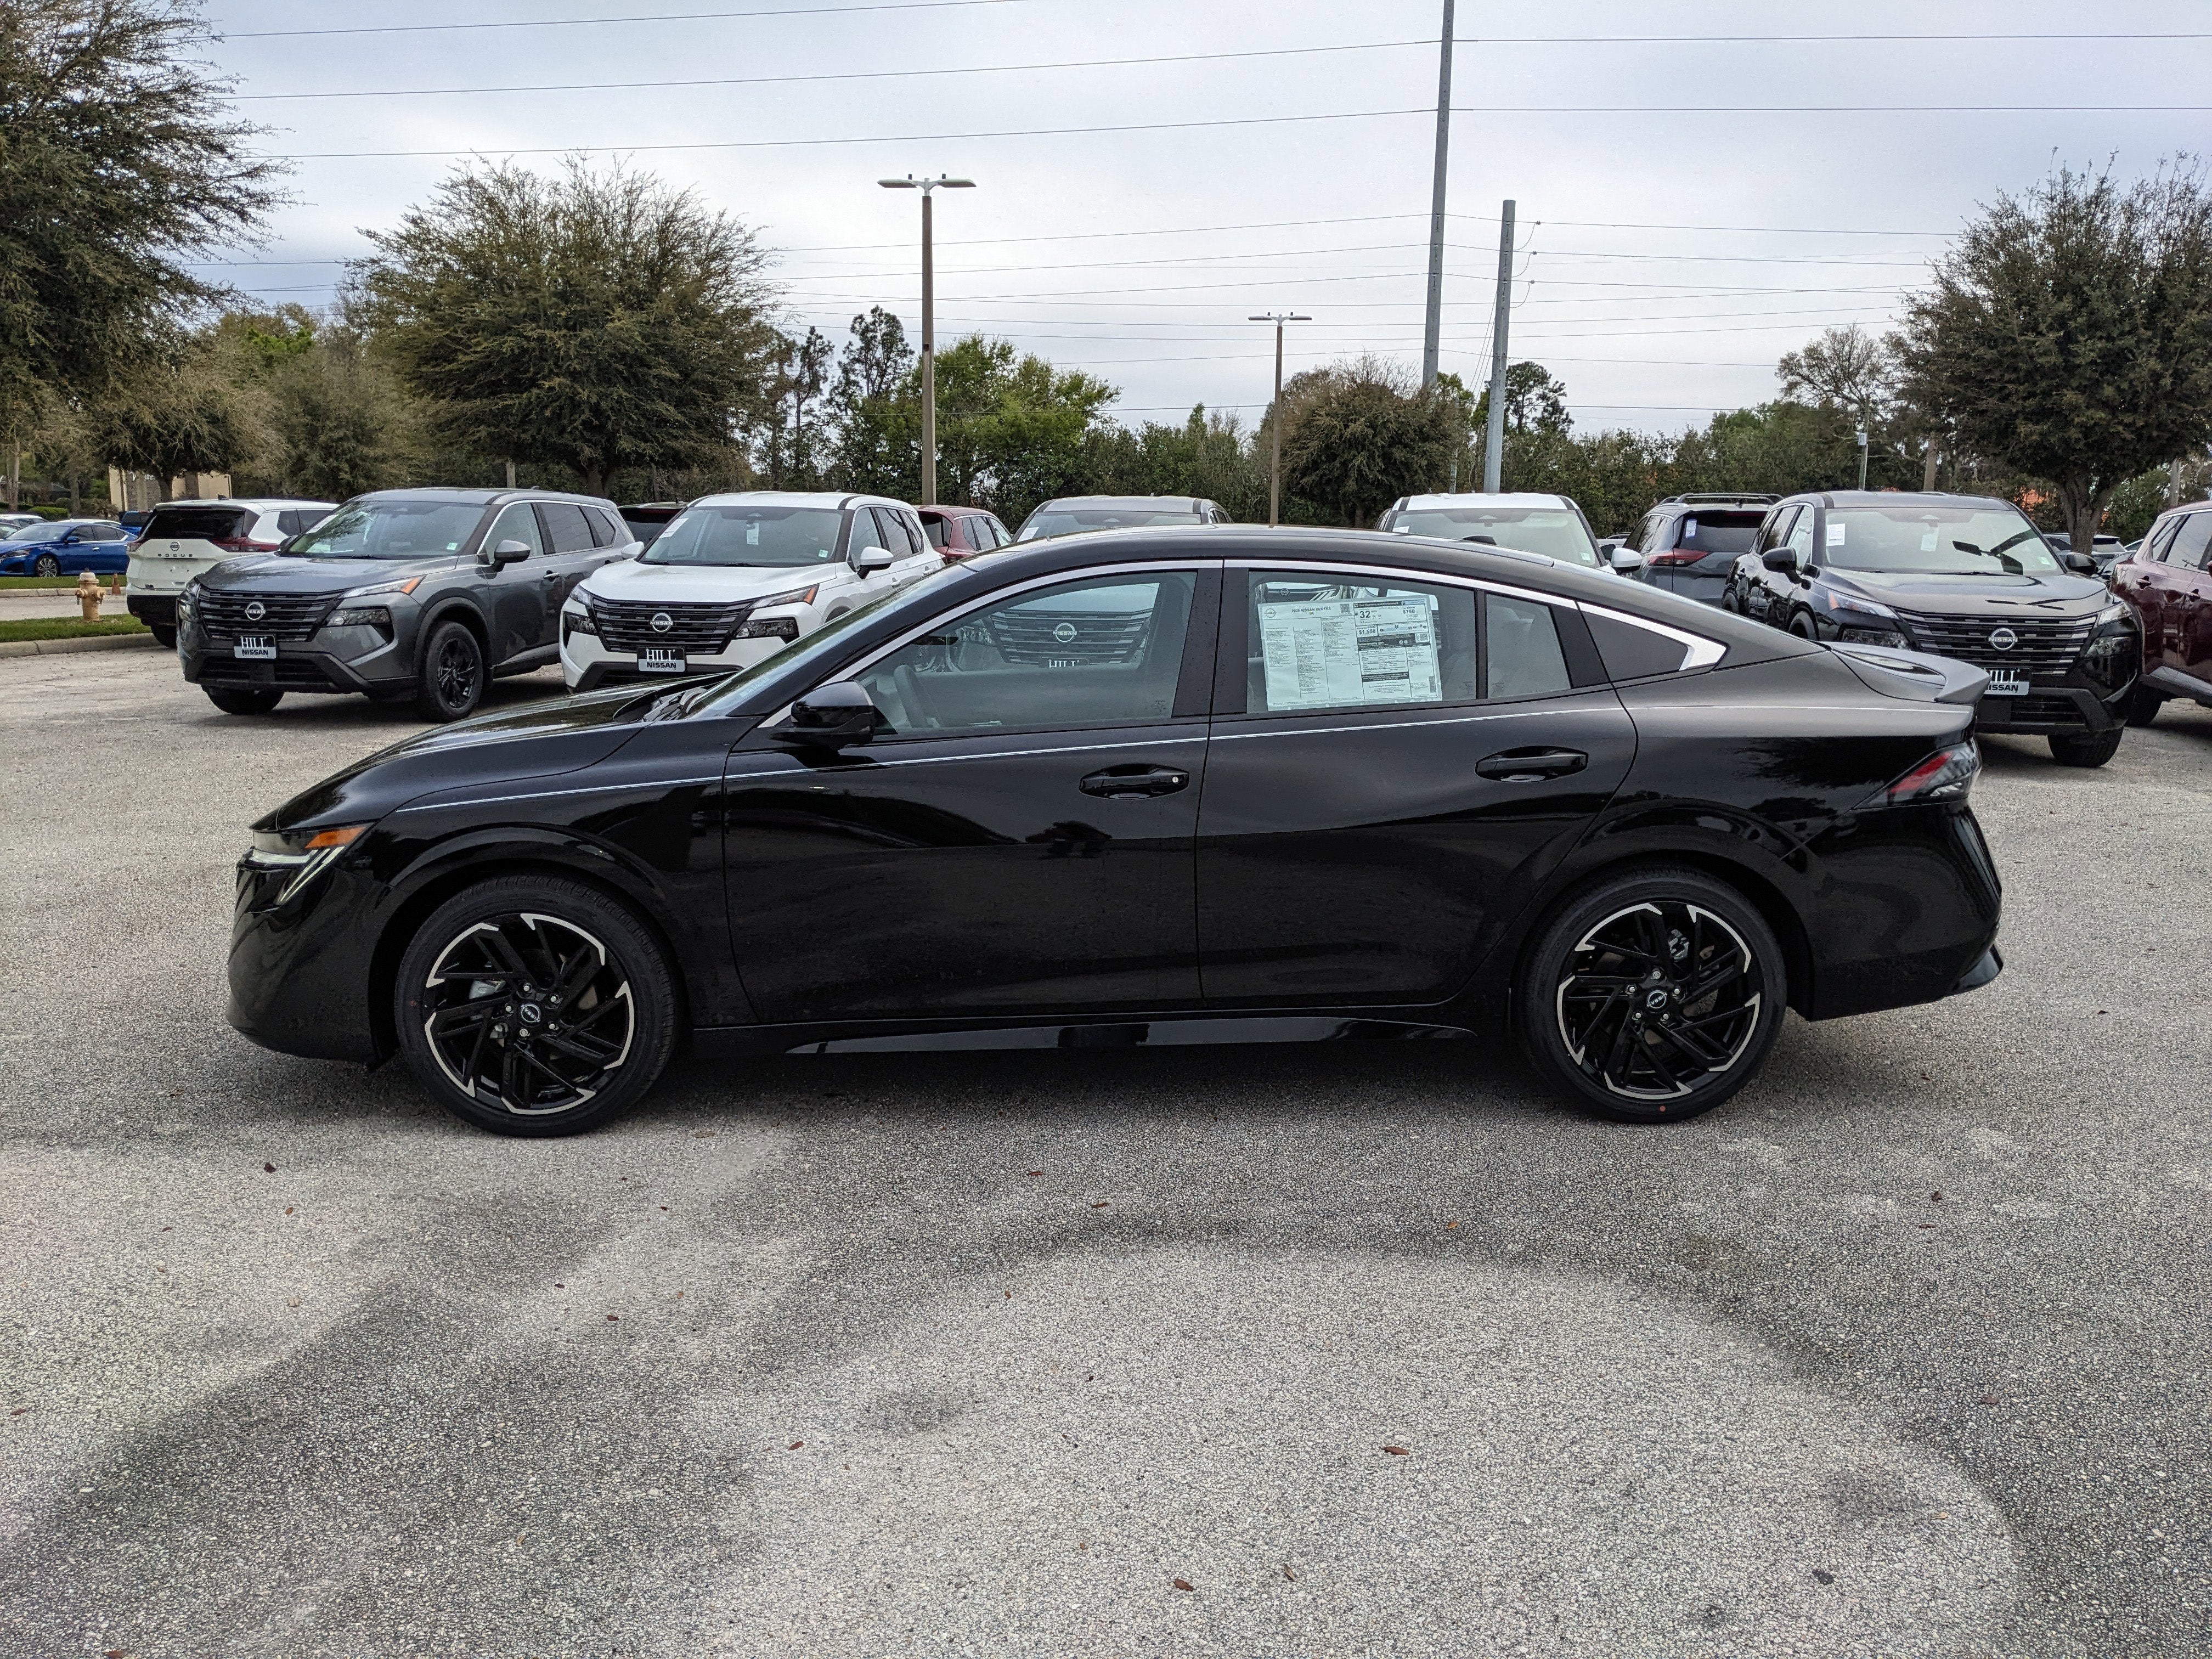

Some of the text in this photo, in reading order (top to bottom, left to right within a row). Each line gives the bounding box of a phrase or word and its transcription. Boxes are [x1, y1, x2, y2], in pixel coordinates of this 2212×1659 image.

[1359, 611, 1371, 619] 32
[241, 637, 268, 649] HILL
[646, 650, 676, 662] HILL
